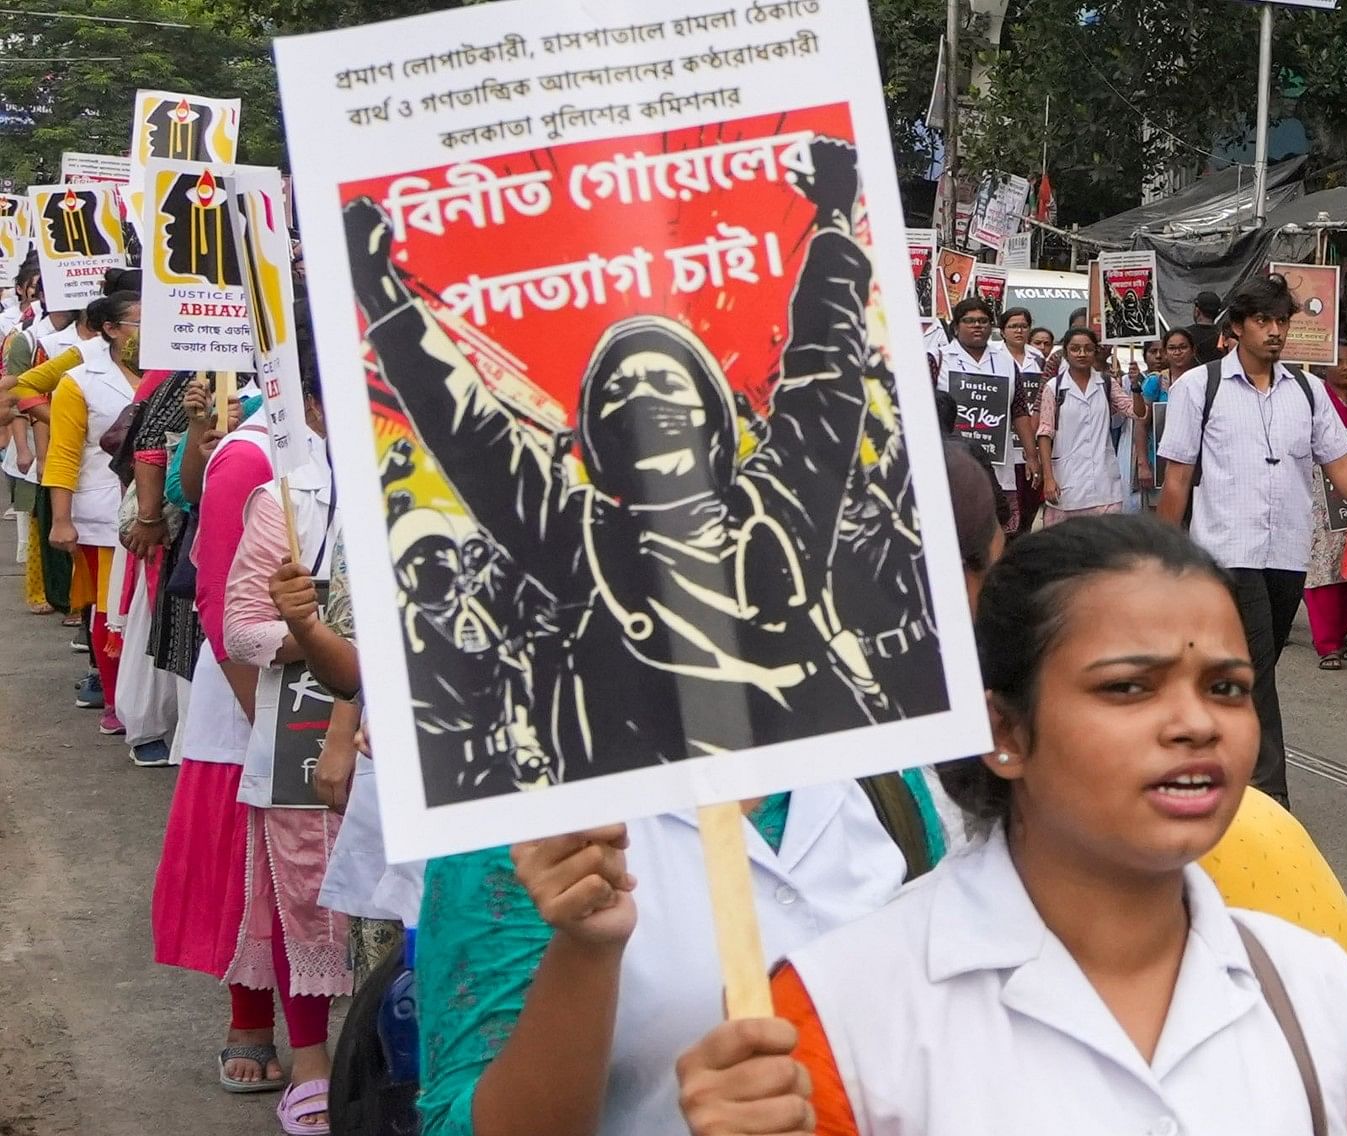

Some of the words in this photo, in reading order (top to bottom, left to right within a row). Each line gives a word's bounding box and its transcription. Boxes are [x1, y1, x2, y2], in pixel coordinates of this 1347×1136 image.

[335, 61, 395, 90] প্রমাণ
[402, 33, 535, 79] লোপাটকারী,
[540, 21, 665, 55] হাসপাতালে
[671, 7, 738, 37] হামলা
[745, 0, 821, 25] ঠেকাতে
[346, 95, 392, 127] ব্যর্থ
[398, 100, 414, 119] ও
[421, 77, 532, 114] গণতান্ত্রিক
[537, 58, 675, 92] আন্দোলনের
[438, 115, 533, 149] কলকাতা
[540, 103, 632, 140] পুলিশের
[639, 86, 742, 120] কমিশনার
[383, 159, 553, 242] বিনীত
[568, 130, 816, 211] গোয়েলের
[438, 246, 656, 326] পদত্যাগ
[664, 222, 784, 293] চাই।
[168, 288, 233, 300] JUSTICE
[1014, 288, 1082, 299] KOLKATA
[173, 323, 194, 334] কেটে
[197, 324, 220, 335] গেছে
[225, 324, 251, 336] এতদি
[171, 341, 206, 352] অভয়ার
[210, 341, 238, 353] বিচার
[960, 380, 998, 393] Justice
[970, 391, 988, 401] for
